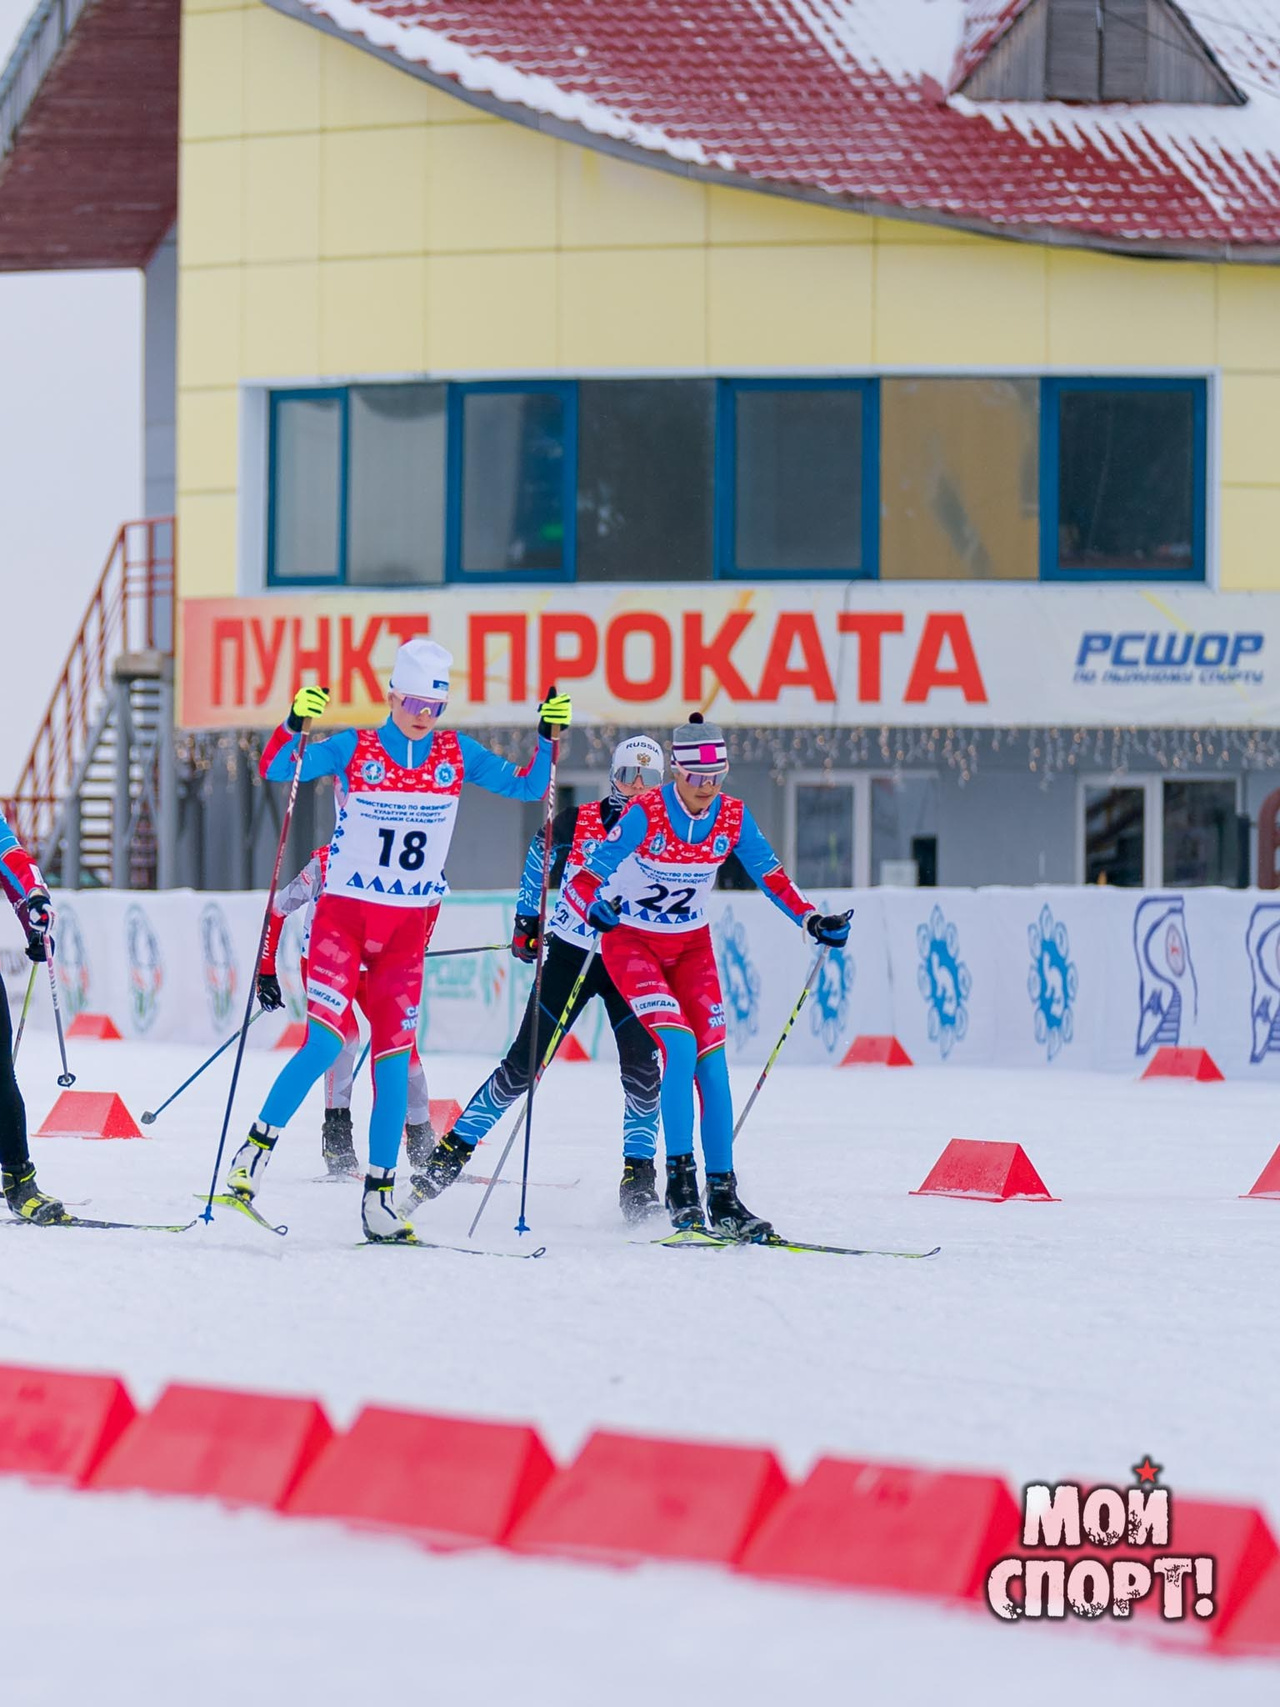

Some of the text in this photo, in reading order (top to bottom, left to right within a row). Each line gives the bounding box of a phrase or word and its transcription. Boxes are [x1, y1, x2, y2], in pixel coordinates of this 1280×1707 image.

[211, 610, 988, 707] ПУНКТ ПРОКАТА
[1075, 632, 1264, 667] РСШОР
[625, 741, 660, 756] RUSSIA
[378, 828, 427, 871] 18
[634, 883, 697, 914] 22
